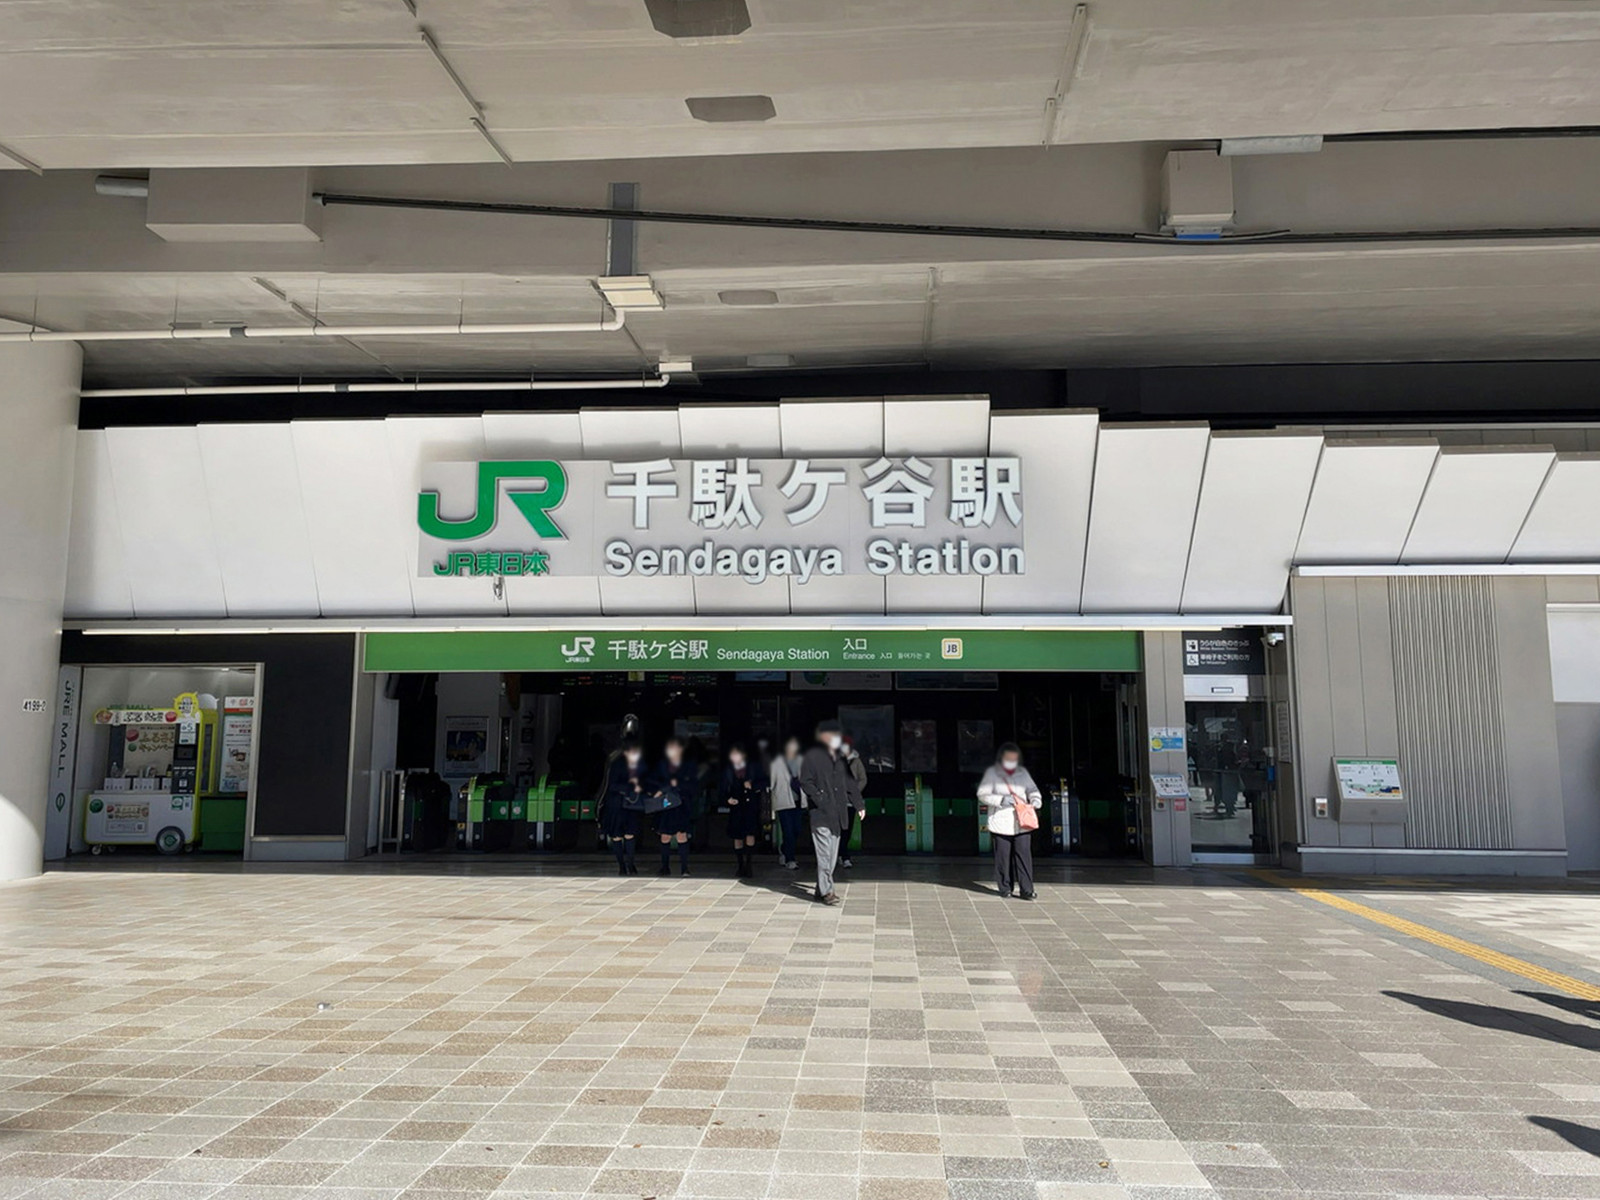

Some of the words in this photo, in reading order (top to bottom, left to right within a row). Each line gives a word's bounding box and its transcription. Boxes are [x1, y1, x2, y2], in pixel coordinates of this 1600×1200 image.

[417, 460, 567, 540] JR
[433, 552, 549, 576] JR東日本
[605, 539, 844, 585] Sendagaya
[866, 538, 1025, 576] Station
[561, 637, 595, 656] JR
[717, 648, 784, 662] Sendagaya
[788, 647, 829, 660] Station
[843, 638, 867, 650] 入口
[946, 644, 958, 653] JB
[843, 651, 876, 660] Entrance
[63, 680, 73, 717] JRE
[58, 722, 69, 779] MALL
